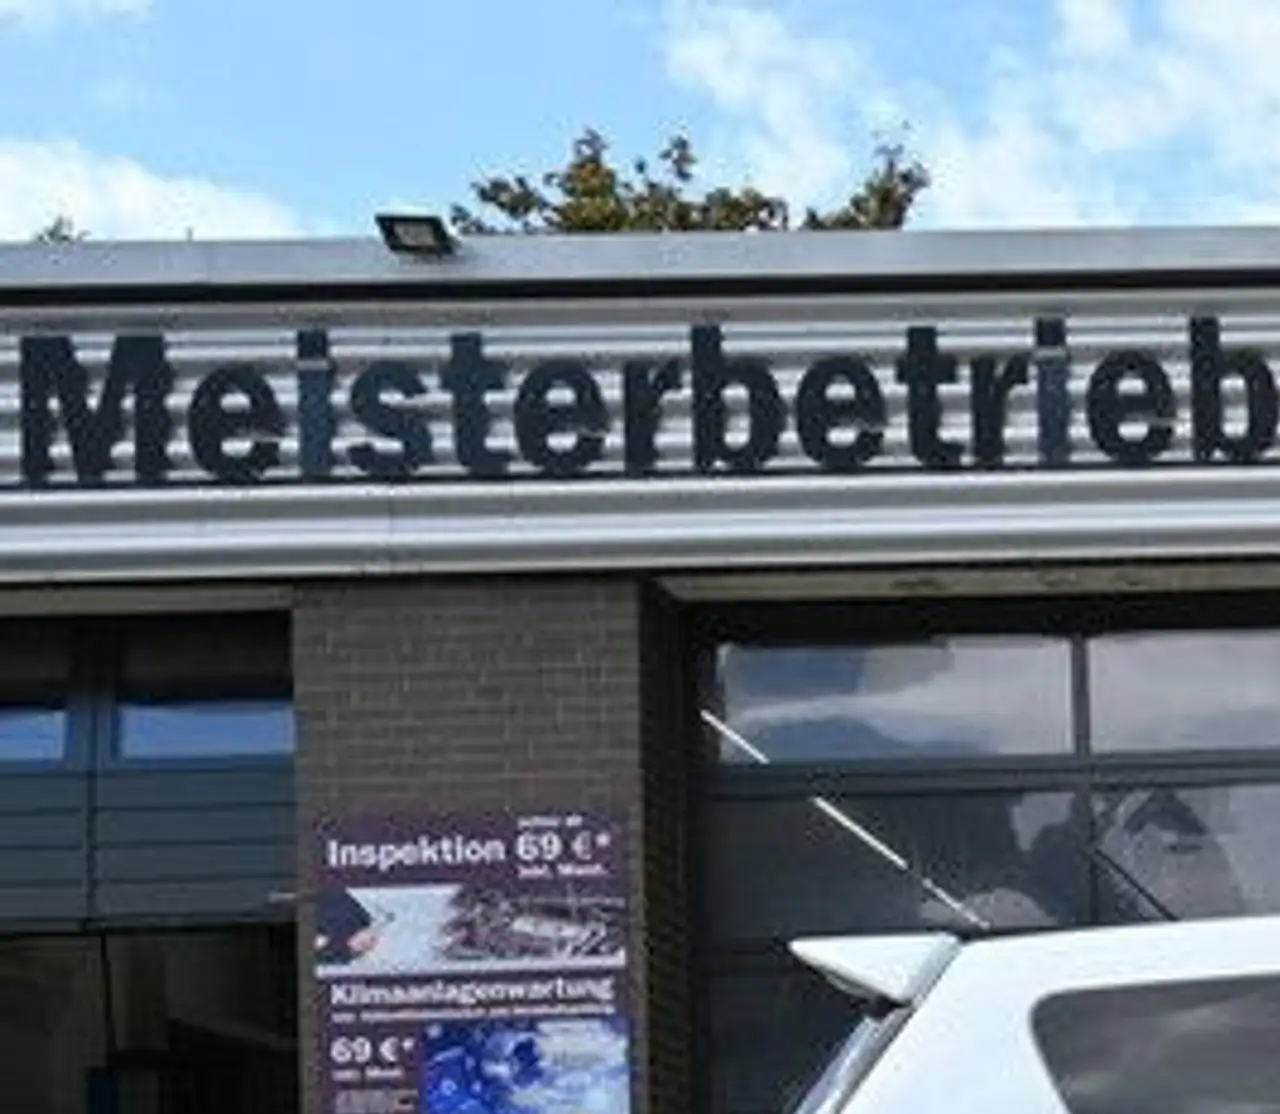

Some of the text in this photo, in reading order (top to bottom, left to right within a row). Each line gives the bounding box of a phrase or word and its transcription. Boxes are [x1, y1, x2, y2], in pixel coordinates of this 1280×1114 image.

[328, 835, 506, 871] Inspektion
[516, 830, 563, 861] 69
[330, 1036, 373, 1064] 69
